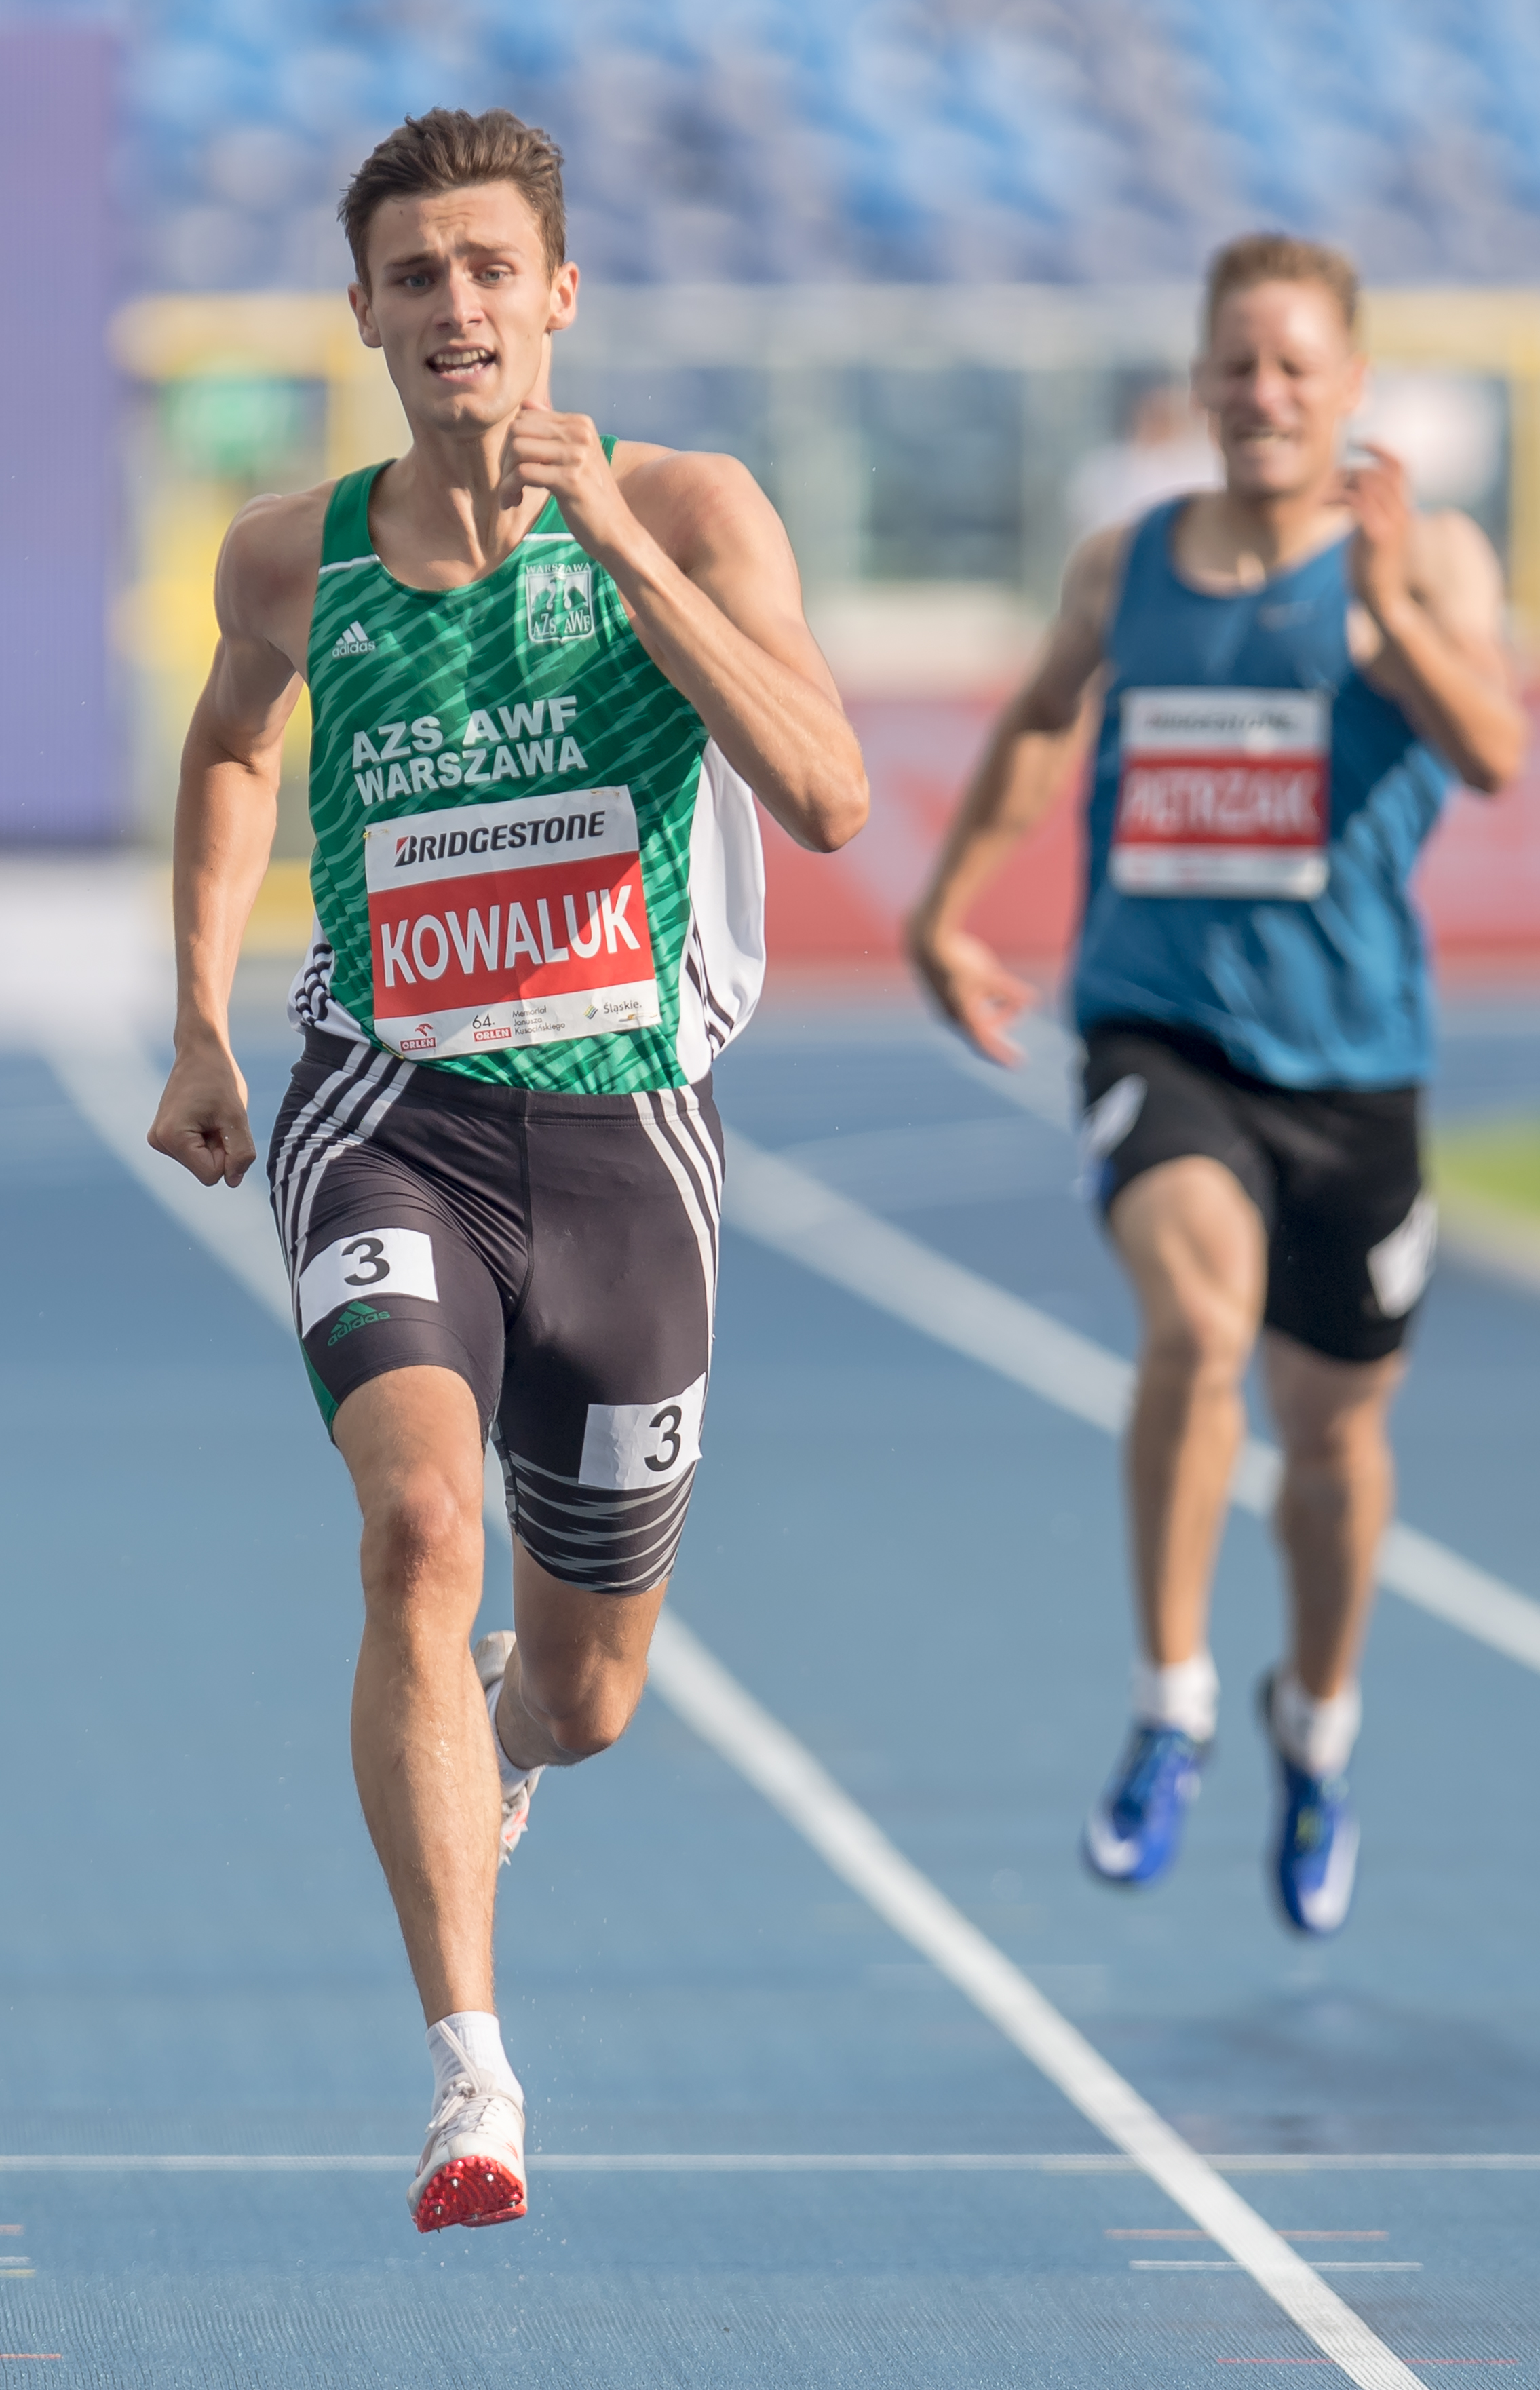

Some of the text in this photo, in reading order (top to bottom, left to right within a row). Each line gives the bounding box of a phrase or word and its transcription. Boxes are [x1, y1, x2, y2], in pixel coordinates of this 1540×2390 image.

[526, 562, 591, 573] WARSZAWA
[533, 609, 590, 636] AZS AWF
[332, 640, 375, 658] adidas
[351, 695, 577, 770] AZS AWF
[353, 735, 588, 806] WARSZAWA
[394, 810, 605, 867] BRIDGESTONE
[380, 884, 640, 988] KOWALUK
[471, 1014, 495, 1029] 64.
[474, 1028, 510, 1041] ORLEN
[514, 1017, 542, 1027] Janusza
[514, 1022, 566, 1035] Kusocińskiego
[402, 1038, 435, 1051] ORLEN
[341, 1237, 390, 1286] 3
[327, 1311, 391, 1347] adidas
[644, 1404, 682, 1473] 3
